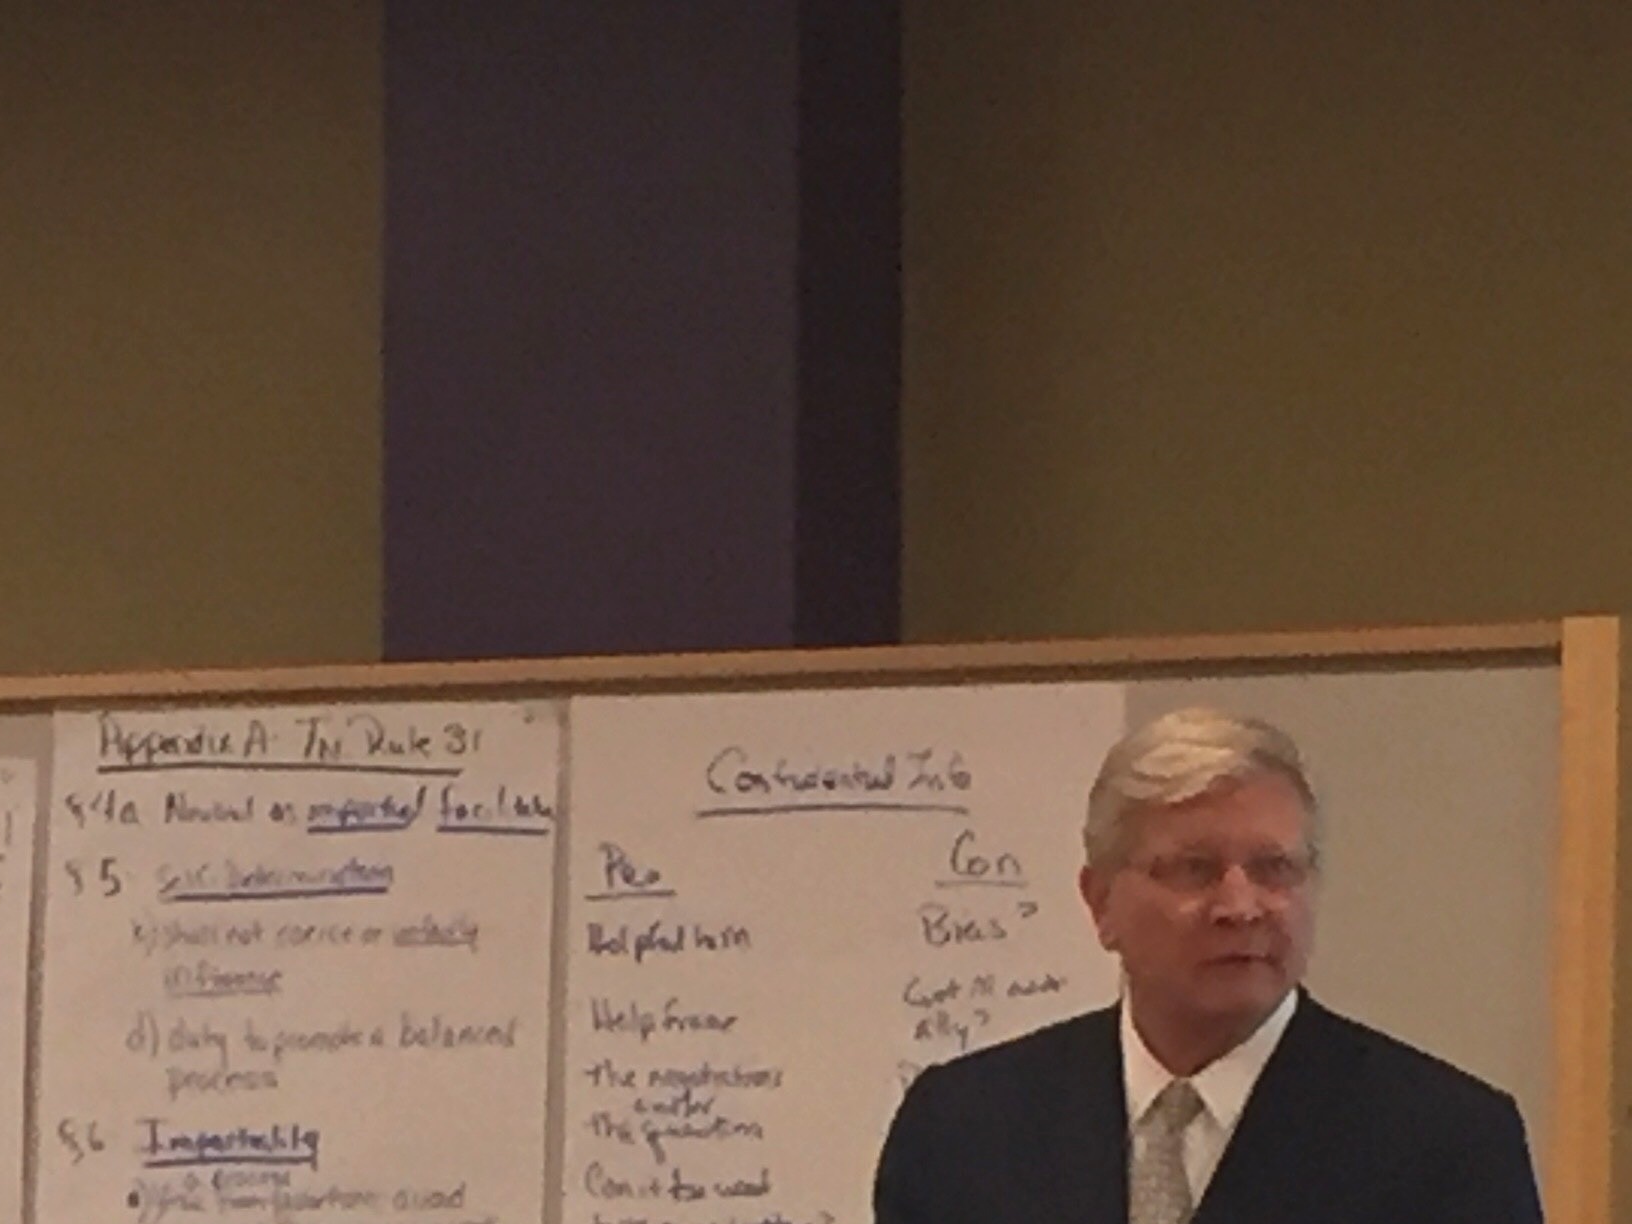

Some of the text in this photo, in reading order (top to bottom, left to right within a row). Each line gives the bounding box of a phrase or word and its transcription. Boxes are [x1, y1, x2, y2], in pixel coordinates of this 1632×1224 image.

[346, 715, 431, 759] Rule
[443, 723, 482, 756] 31
[948, 828, 1023, 877] Con
